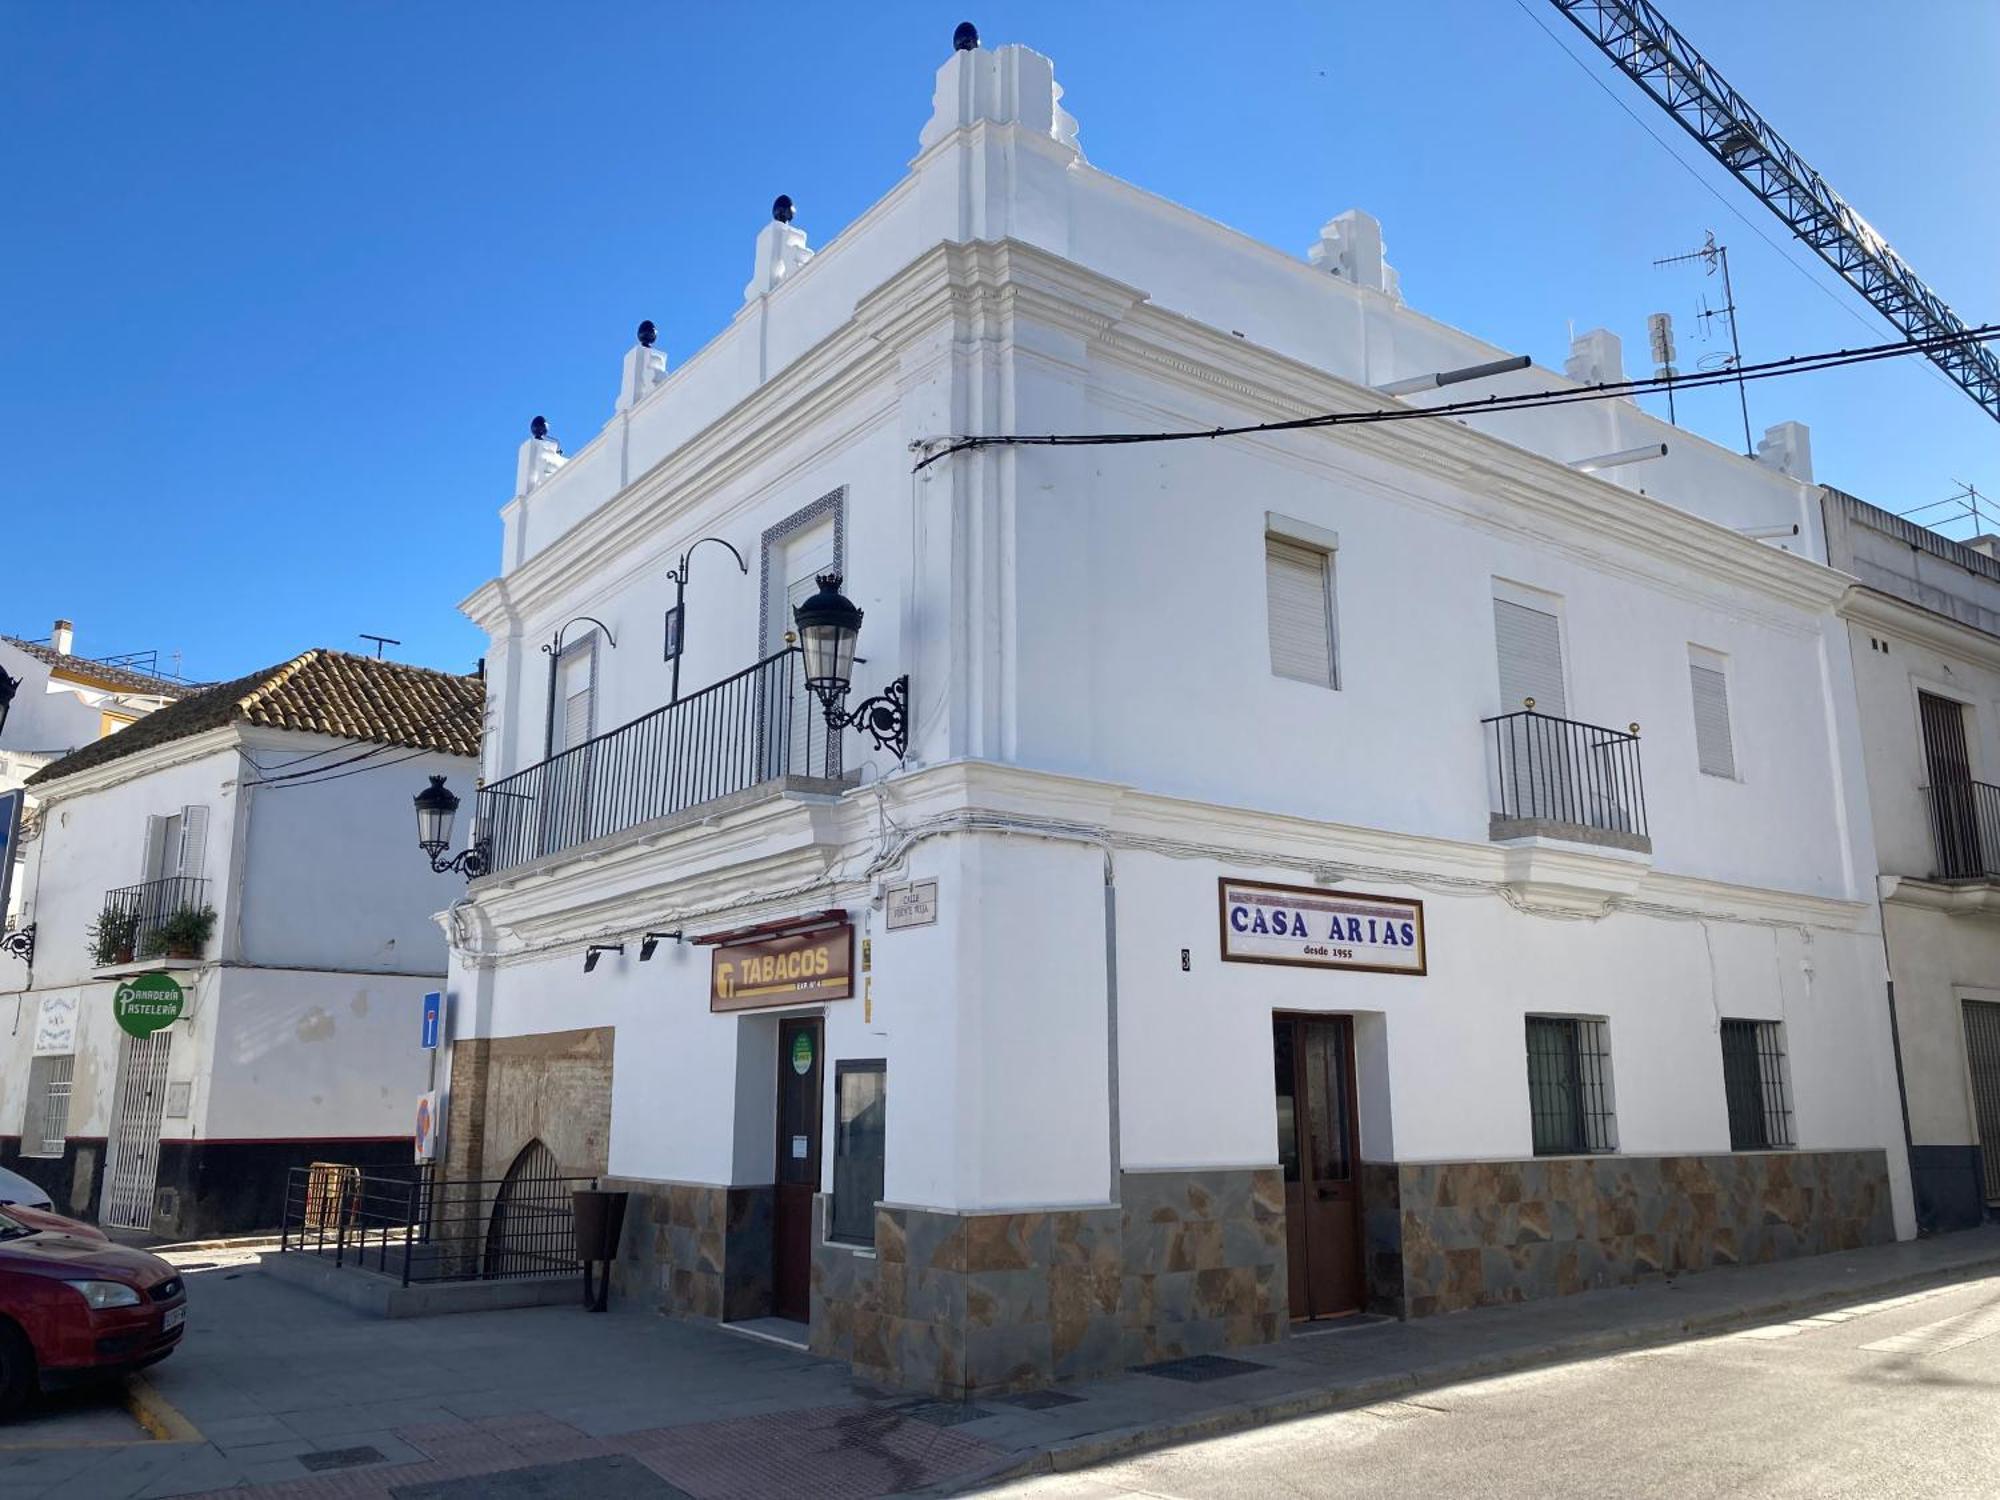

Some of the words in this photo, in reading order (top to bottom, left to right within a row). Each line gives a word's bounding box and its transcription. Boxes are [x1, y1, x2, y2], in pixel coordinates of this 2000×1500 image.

[1231, 906, 1308, 938] CASA
[1329, 915, 1414, 946] ARIAS
[741, 946, 828, 985] TABACOS
[1303, 945, 1328, 956] desde
[1333, 948, 1352, 958] 1955
